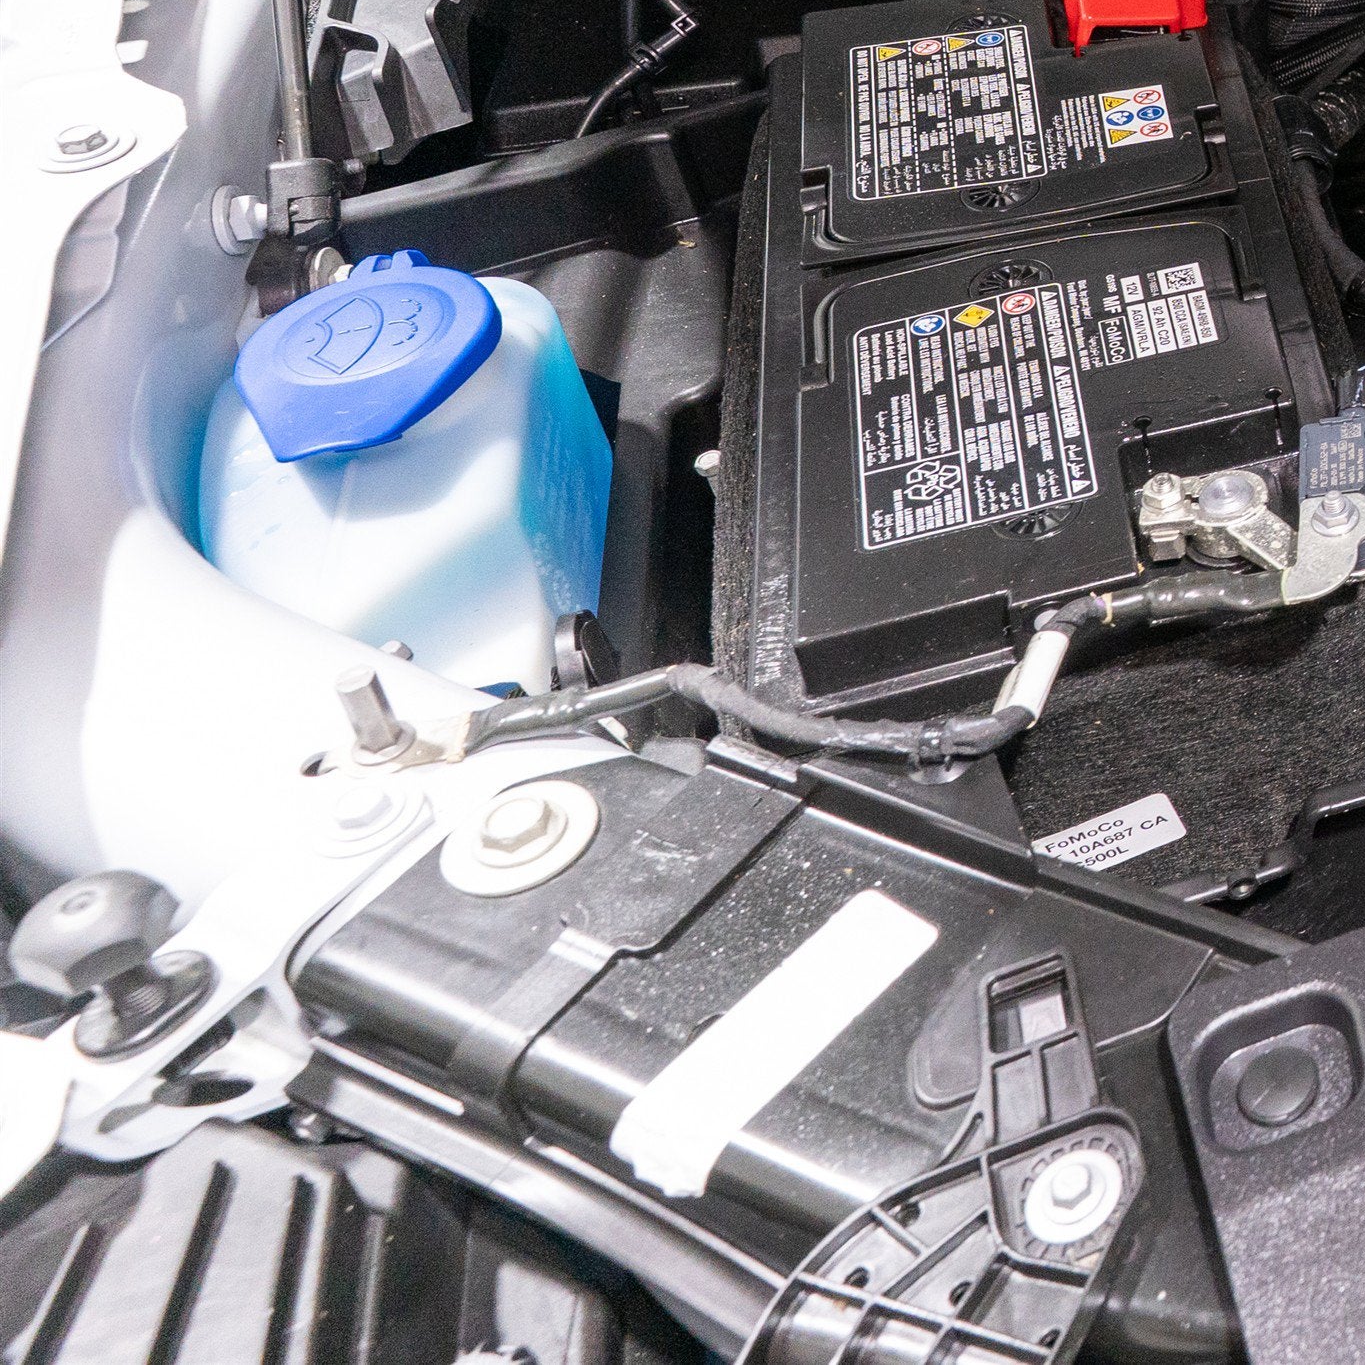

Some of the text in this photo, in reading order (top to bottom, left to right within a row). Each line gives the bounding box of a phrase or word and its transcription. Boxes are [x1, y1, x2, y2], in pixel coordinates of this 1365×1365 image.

[1125, 281, 1138, 295] 12V
[1102, 295, 1121, 314] MF
[1151, 305, 1163, 316] 92
[1042, 298, 1066, 359] DANGER/POISON
[1131, 308, 1150, 352] AGM/VRLA
[1154, 316, 1166, 328] Ah
[1157, 328, 1170, 346] C20
[1104, 318, 1125, 362] FoMoCo
[900, 393, 912, 421] CONTRA
[1054, 373, 1080, 439] PELIGRO/VENENO
[1044, 818, 1124, 853] FoMoCo
[1068, 814, 1168, 857] 10A687 CA
